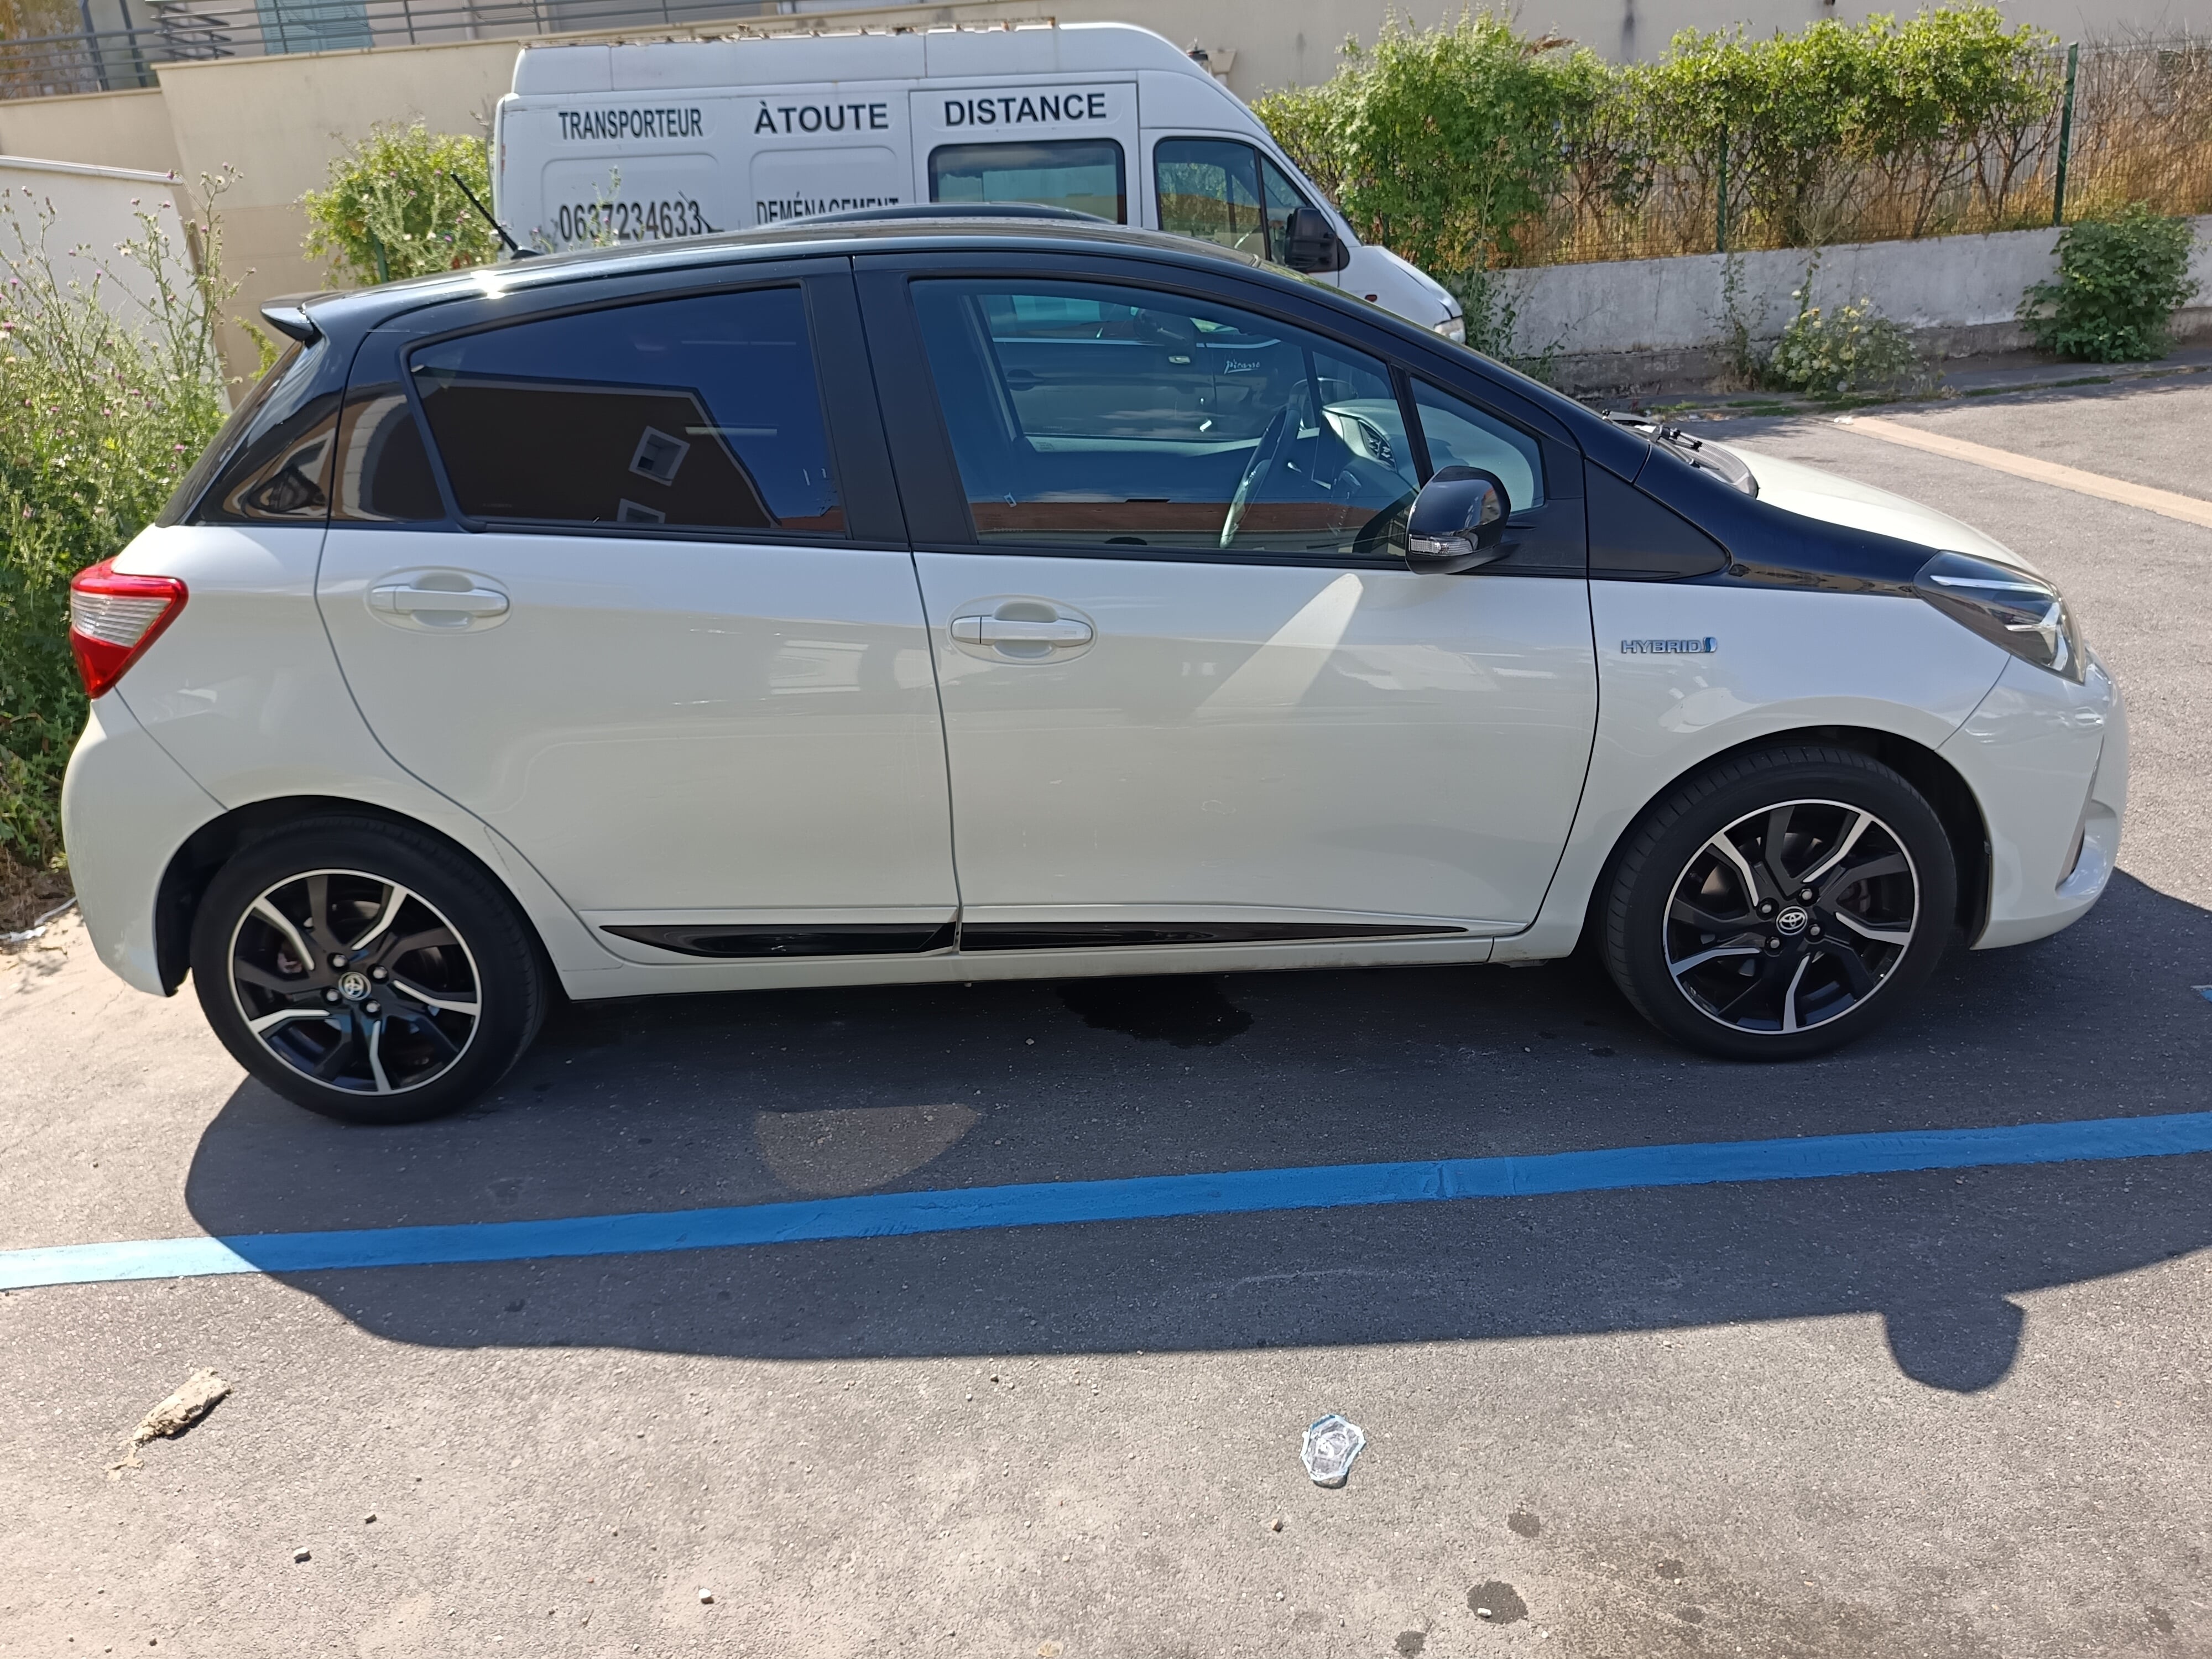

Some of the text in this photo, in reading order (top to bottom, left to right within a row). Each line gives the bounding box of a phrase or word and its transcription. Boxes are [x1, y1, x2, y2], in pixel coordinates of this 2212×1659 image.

[559, 108, 703, 139] TRANSPORTEUR
[944, 93, 1106, 127] DISTANCE
[560, 201, 702, 242] 0637234633
[756, 191, 899, 225] DEMÉNA
[1621, 640, 1702, 654] HYBRID
